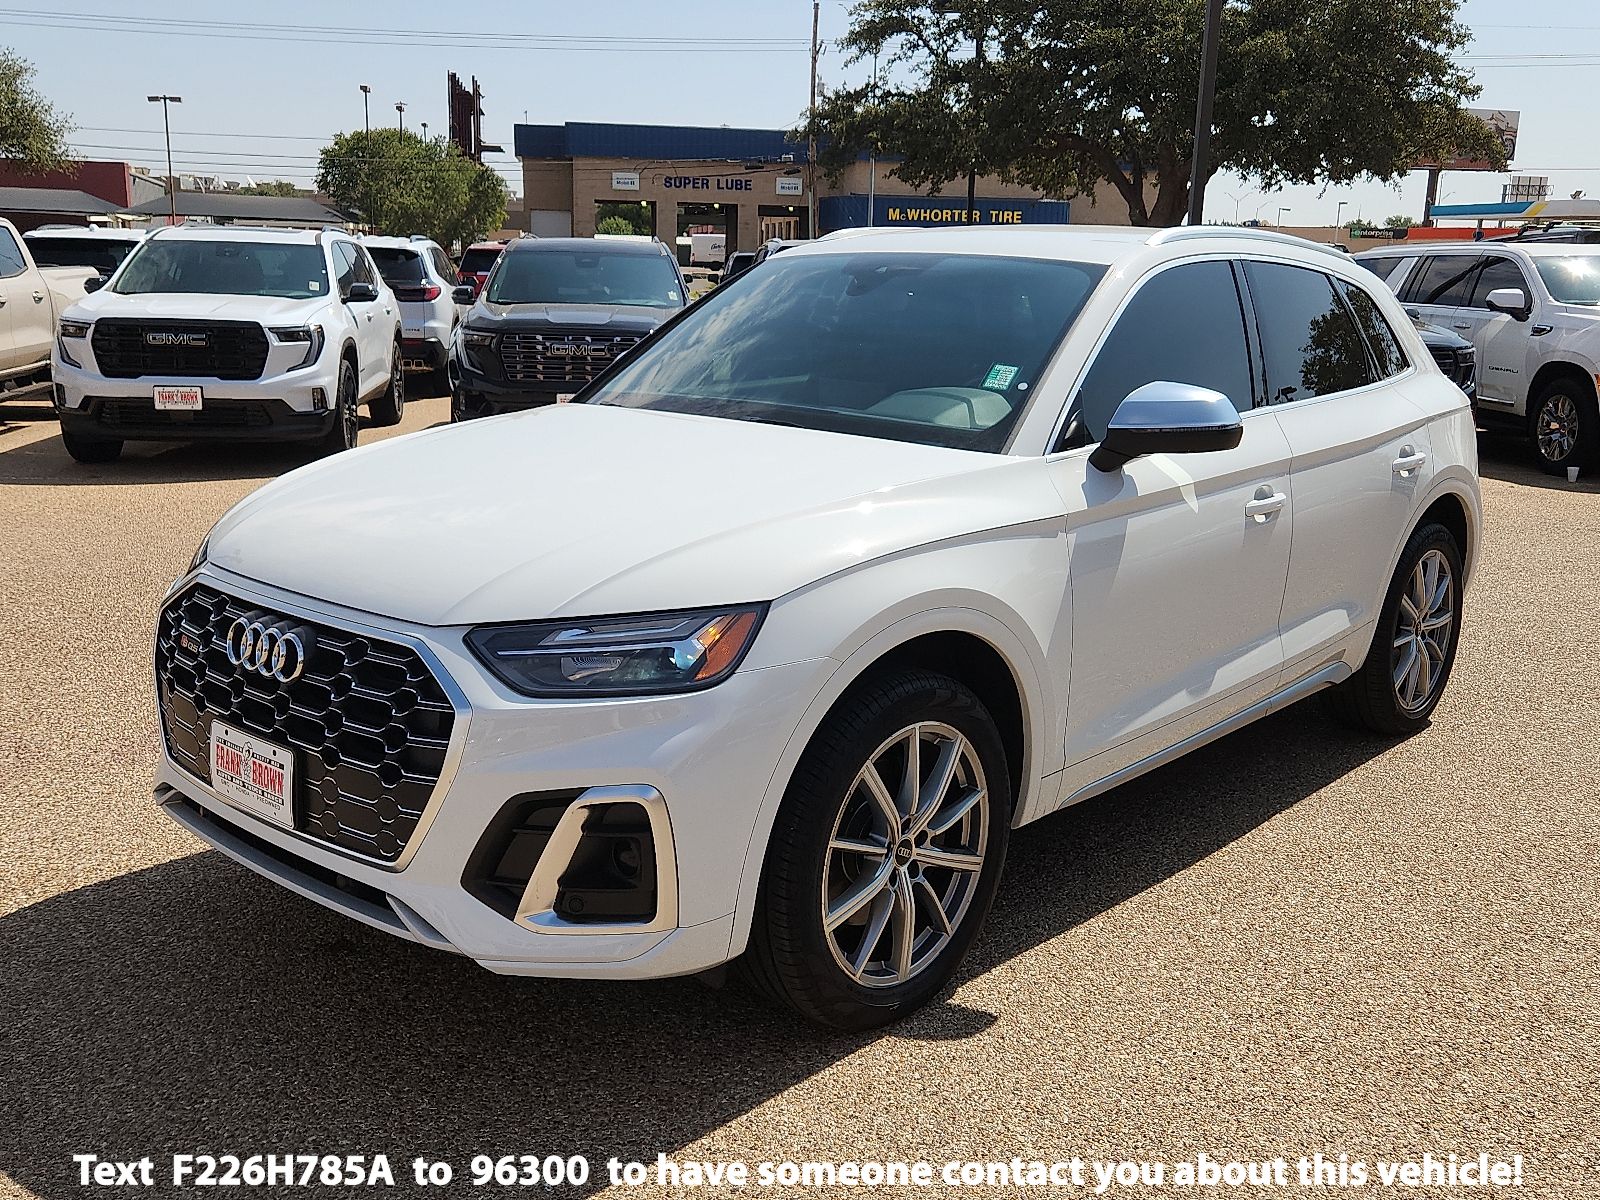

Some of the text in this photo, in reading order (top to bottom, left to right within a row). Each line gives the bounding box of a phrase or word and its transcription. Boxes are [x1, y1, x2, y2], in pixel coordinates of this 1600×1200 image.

[663, 175, 753, 191] SUPER LUBE
[888, 207, 1022, 224] McWHORTER TIRE
[146, 332, 208, 347] GMC
[551, 343, 609, 356] GMC
[1488, 365, 1519, 374] DENALI
[215, 743, 242, 779] FRANK
[251, 759, 284, 798] BROWN
